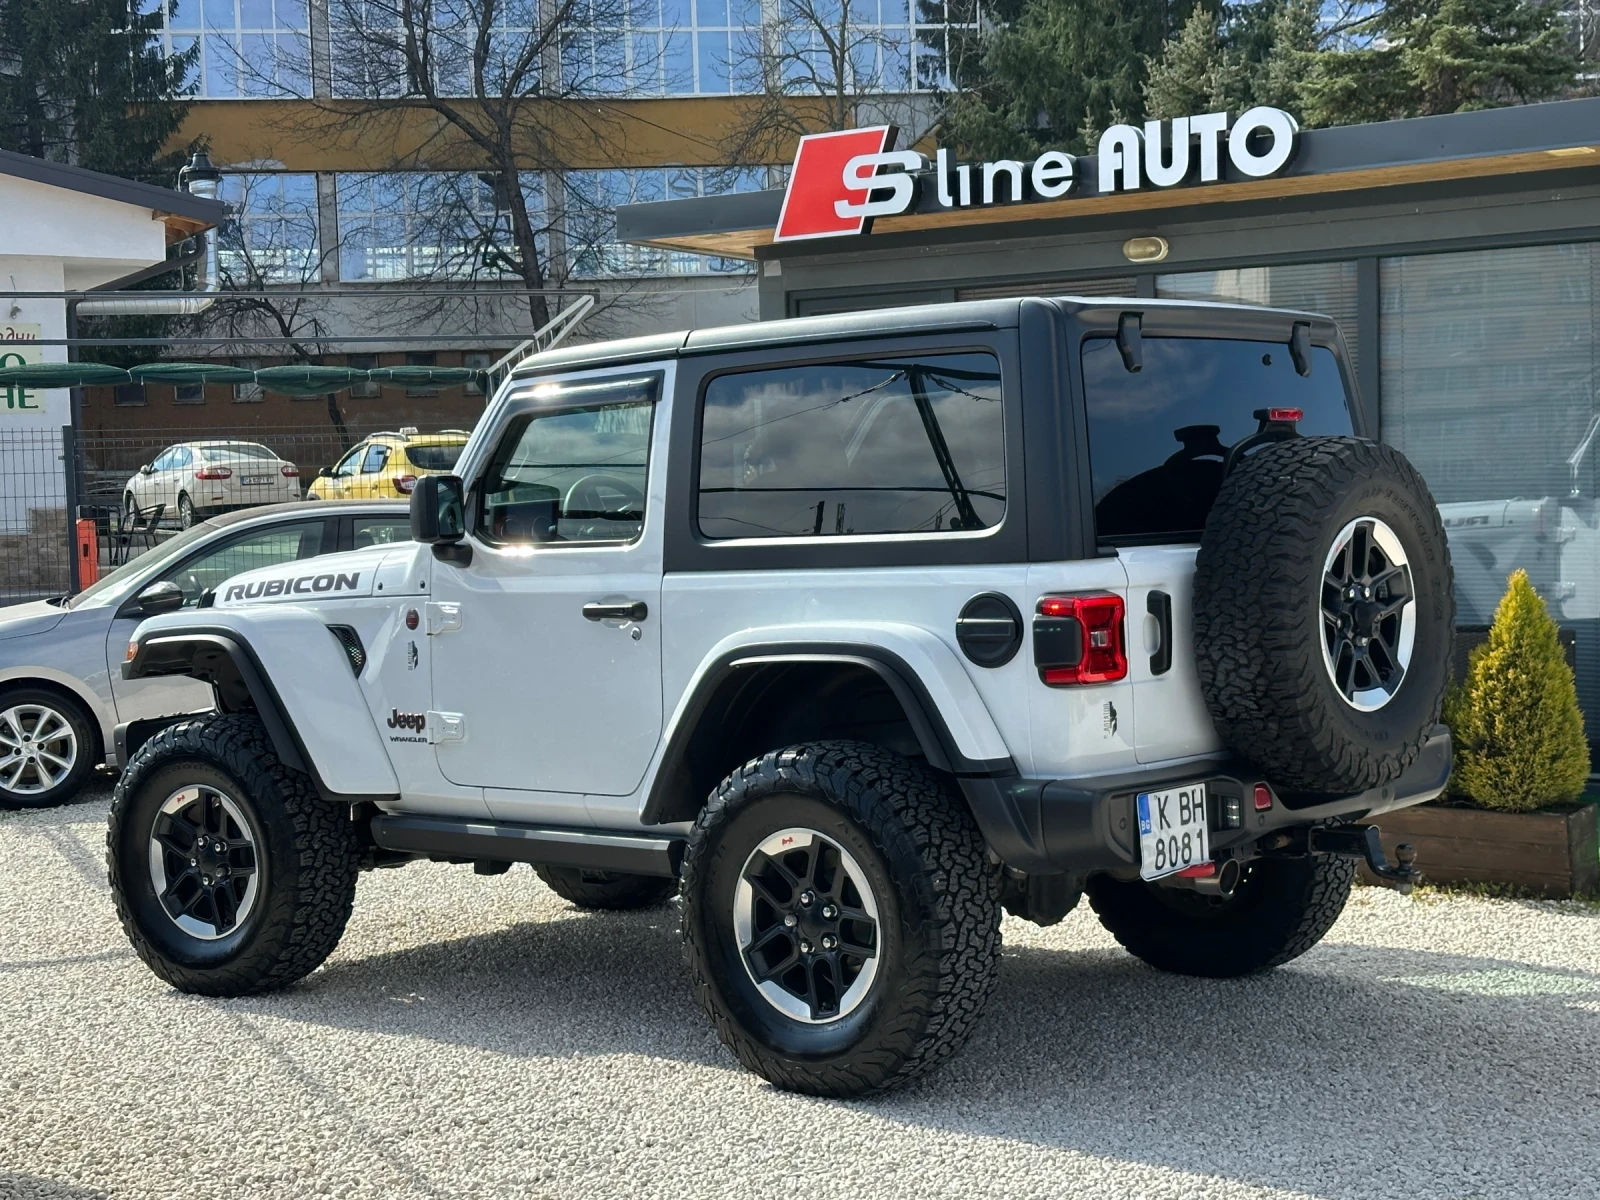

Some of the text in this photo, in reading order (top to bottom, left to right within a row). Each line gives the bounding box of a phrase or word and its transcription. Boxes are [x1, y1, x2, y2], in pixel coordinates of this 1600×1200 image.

[834, 106, 1295, 219] S line AUTO
[224, 572, 360, 602] RUBICON
[386, 707, 426, 734] Jeep
[1141, 820, 1151, 831] BG
[1157, 788, 1204, 830] K BH
[1154, 828, 1204, 871] 8081
